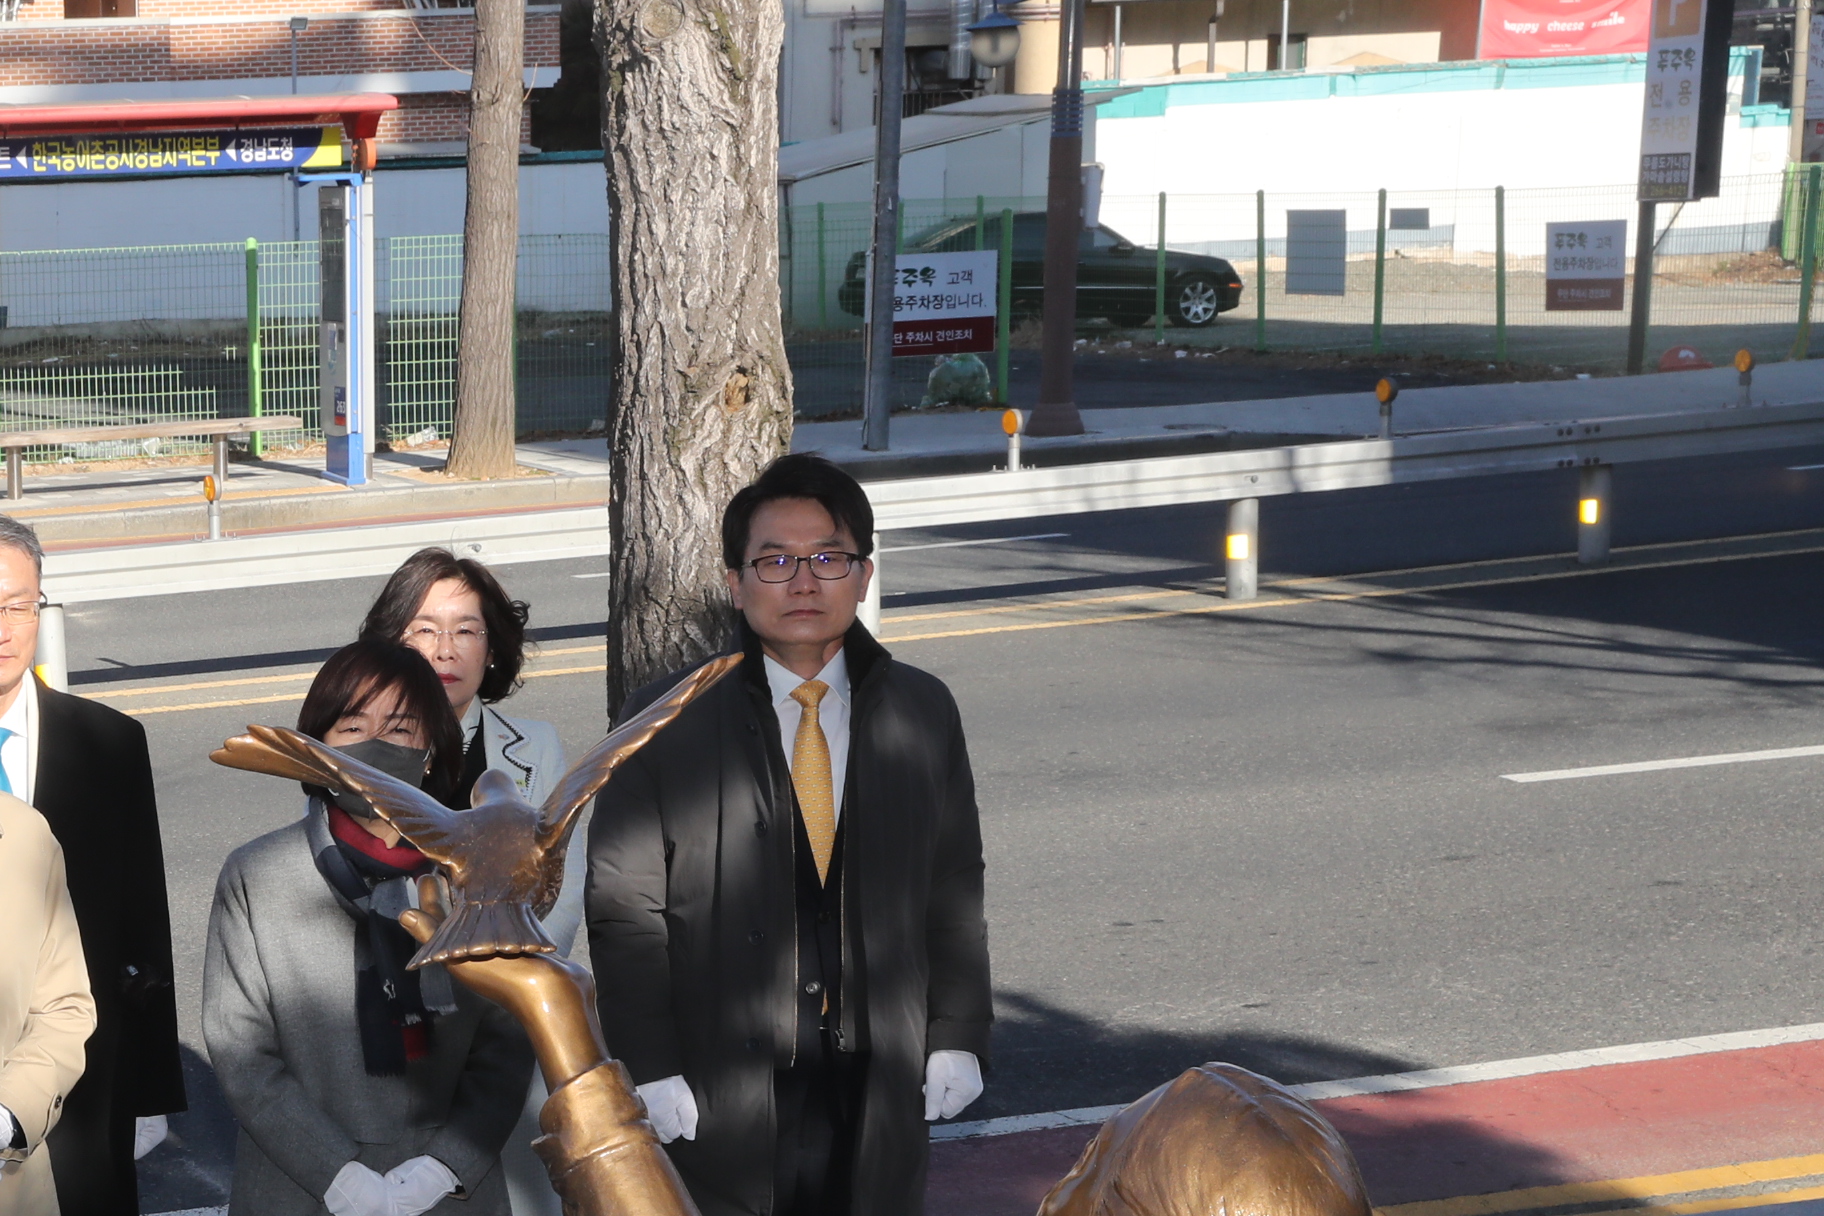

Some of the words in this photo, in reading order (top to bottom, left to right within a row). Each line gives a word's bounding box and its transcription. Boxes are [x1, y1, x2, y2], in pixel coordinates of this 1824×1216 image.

[1504, 19, 1539, 34] happy
[1547, 20, 1585, 32] cheese
[1591, 11, 1625, 29] smile
[1647, 115, 1690, 142] 주차장
[31, 137, 221, 171] 한국농어촌공사경남지역본부
[239, 138, 293, 163] 경남도청
[947, 269, 973, 285] 고객
[893, 293, 987, 312] 용주차장입니다.
[905, 331, 933, 344] 주차시
[936, 329, 973, 342] 견인조치
